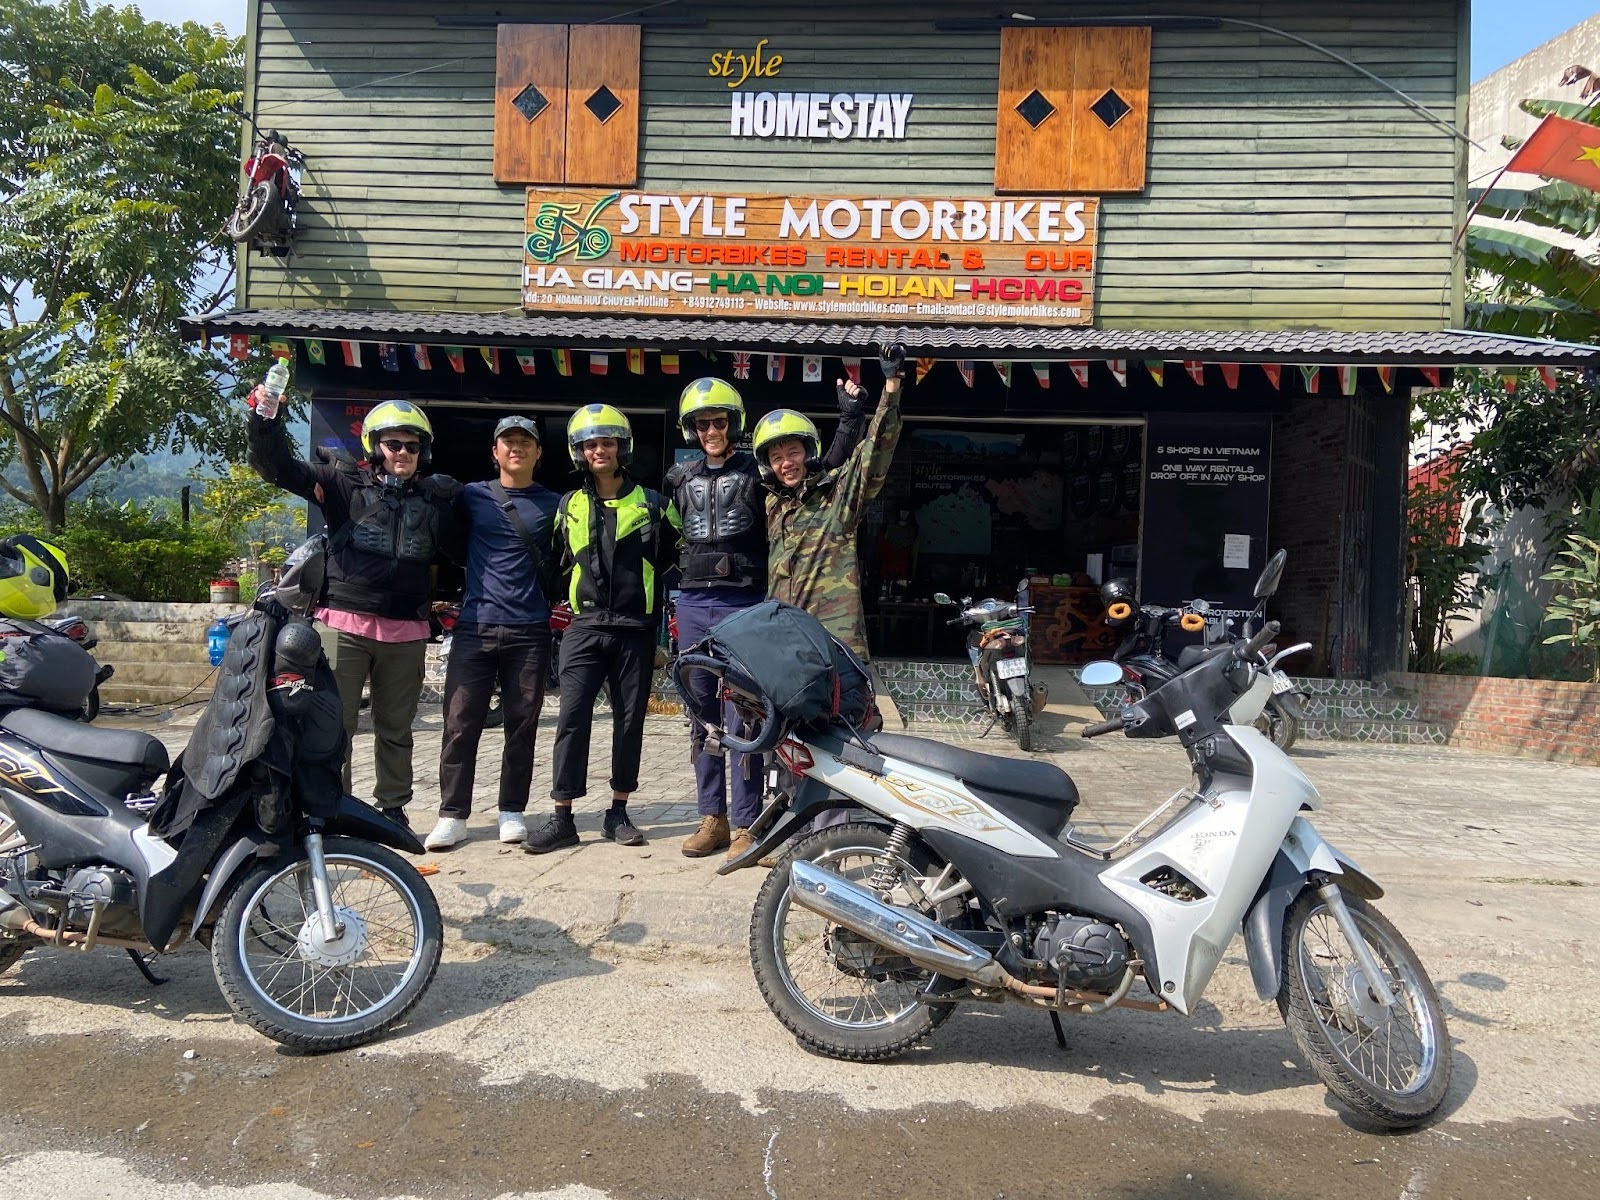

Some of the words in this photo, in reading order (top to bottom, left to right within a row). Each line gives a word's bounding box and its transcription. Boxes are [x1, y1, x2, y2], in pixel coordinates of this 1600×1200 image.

[708, 38, 783, 87] style
[730, 91, 913, 139] HOMESTAY
[619, 194, 746, 237] STYLE
[779, 199, 1085, 242] MOTORBIKES
[620, 242, 807, 266] MOTORBIKES
[825, 246, 950, 269] RENTAL
[962, 249, 985, 270] &
[1025, 250, 1092, 272] OUR
[522, 266, 575, 288] HA
[541, 293, 553, 304] 20
[555, 294, 582, 305] HOANG
[682, 296, 745, 310] +84912749113
[1157, 446, 1164, 454] 5
[1166, 446, 1200, 454] SHOPS
[1203, 447, 1213, 455] IN
[1216, 447, 1260, 455] VIETNAM
[1150, 472, 1176, 480] DROP
[1201, 473, 1210, 481] IN
[1238, 474, 1266, 482] SHOP
[1162, 464, 1182, 472] ONE
[1210, 465, 1254, 473] RENTALS
